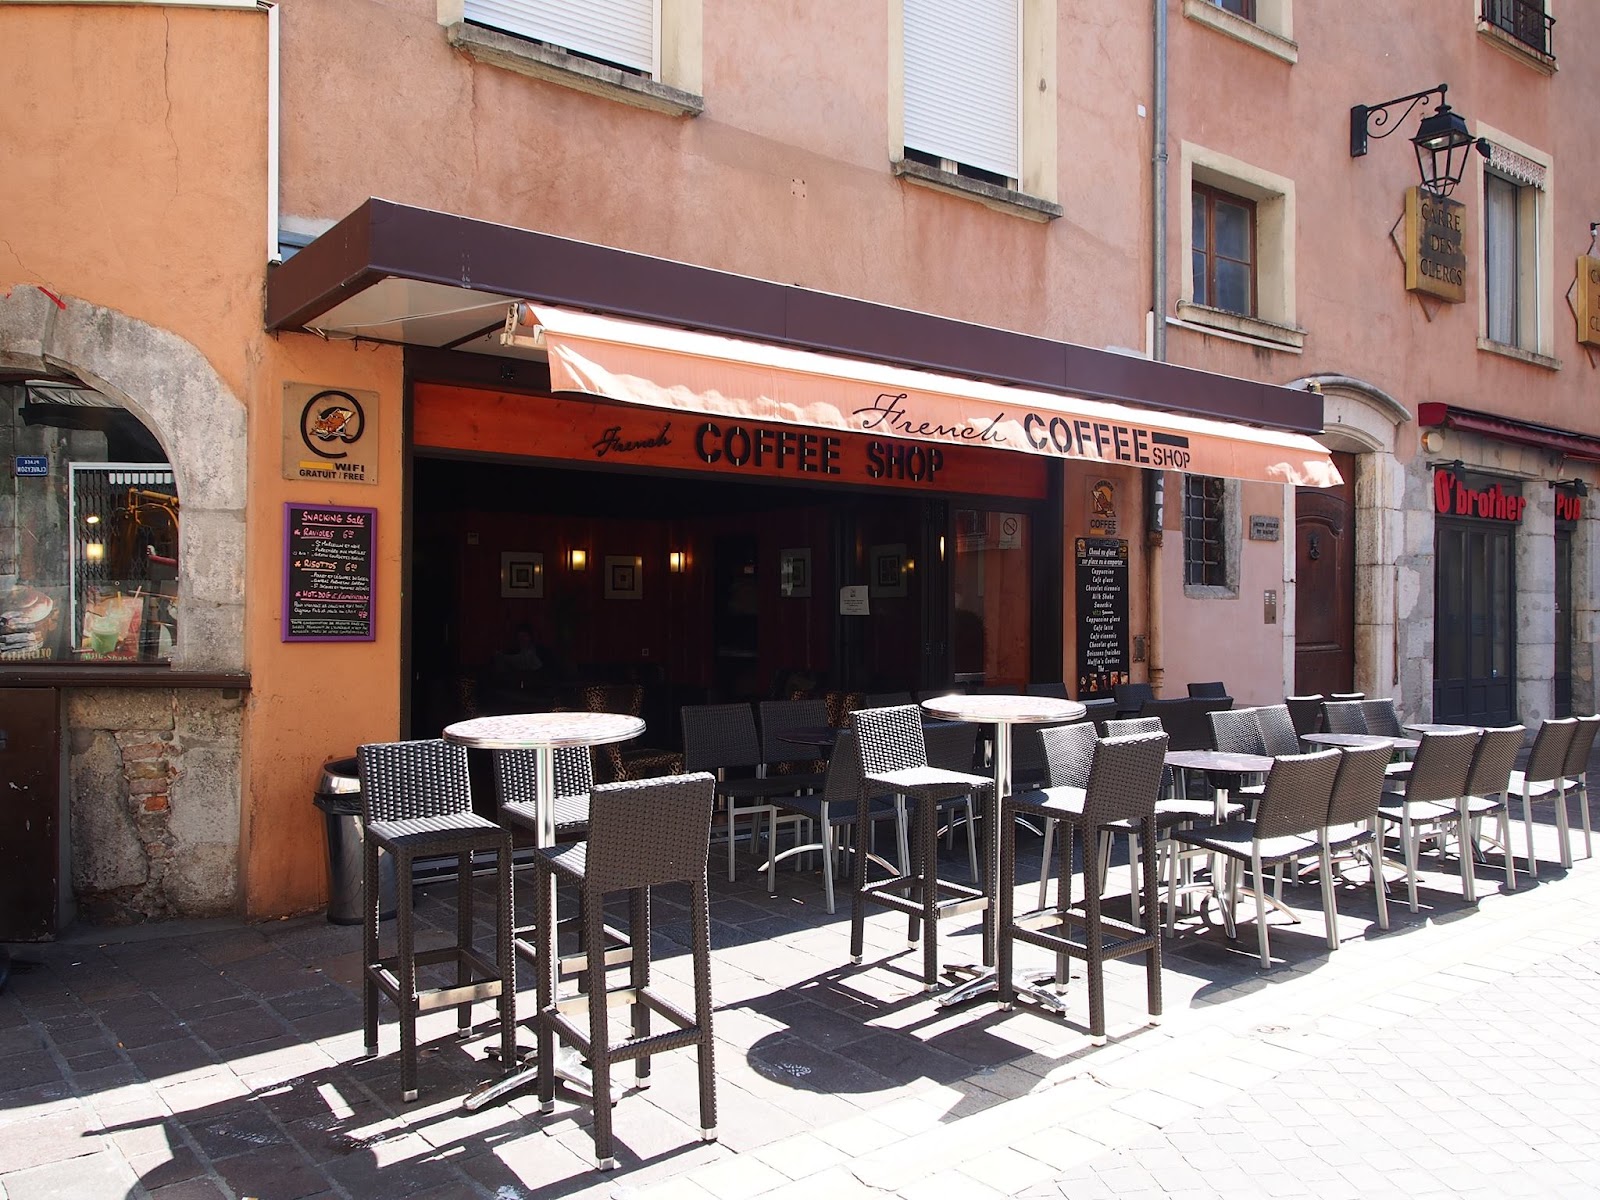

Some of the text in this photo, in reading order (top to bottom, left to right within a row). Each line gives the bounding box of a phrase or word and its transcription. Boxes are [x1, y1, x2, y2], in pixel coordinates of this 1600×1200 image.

[1421, 203, 1461, 233] CARRE
[1431, 234, 1452, 255] DES
[1420, 258, 1462, 286] CLERCS
[852, 392, 1191, 469] French COFFEE SHOP
[594, 421, 944, 482] French COFFEE SHOP
[299, 469, 337, 479] GRATUIT
[343, 472, 365, 481] FREE
[335, 462, 365, 472] WIFI
[1434, 468, 1581, 521] O'brother PUB
[1090, 519, 1117, 529] COFFEE
[303, 559, 338, 570] RISOTTOS
